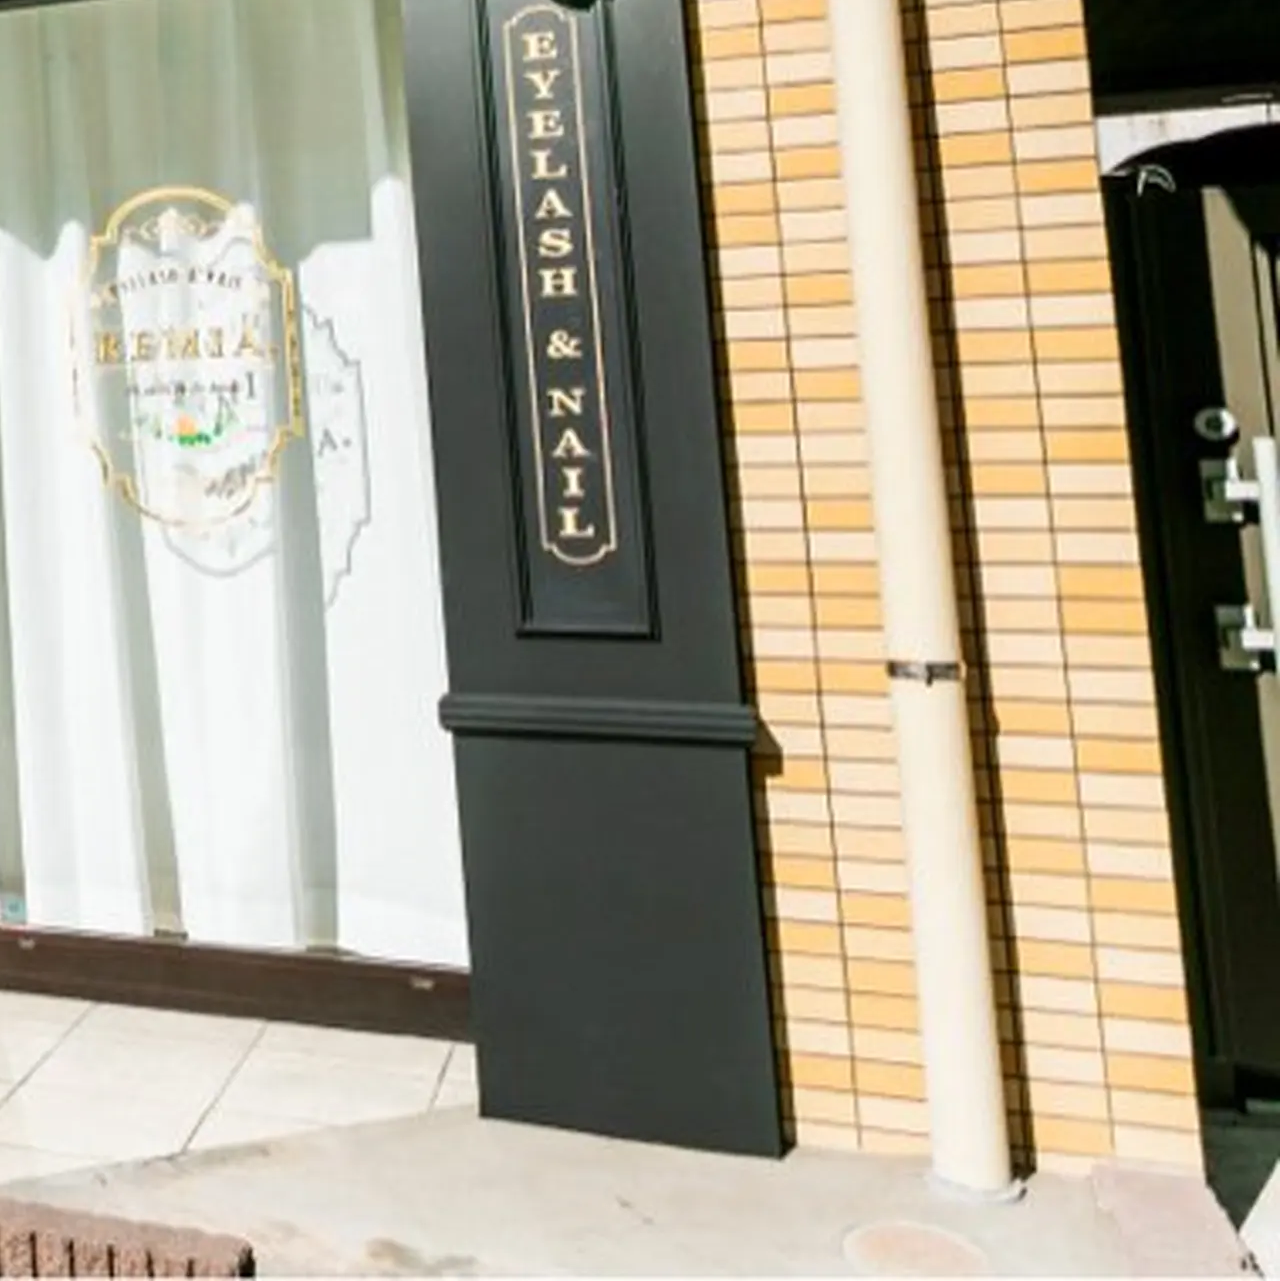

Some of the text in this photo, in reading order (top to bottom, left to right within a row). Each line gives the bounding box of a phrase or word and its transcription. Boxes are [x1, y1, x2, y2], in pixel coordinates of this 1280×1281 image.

[521, 31, 596, 539] EYELASH & NAIL
